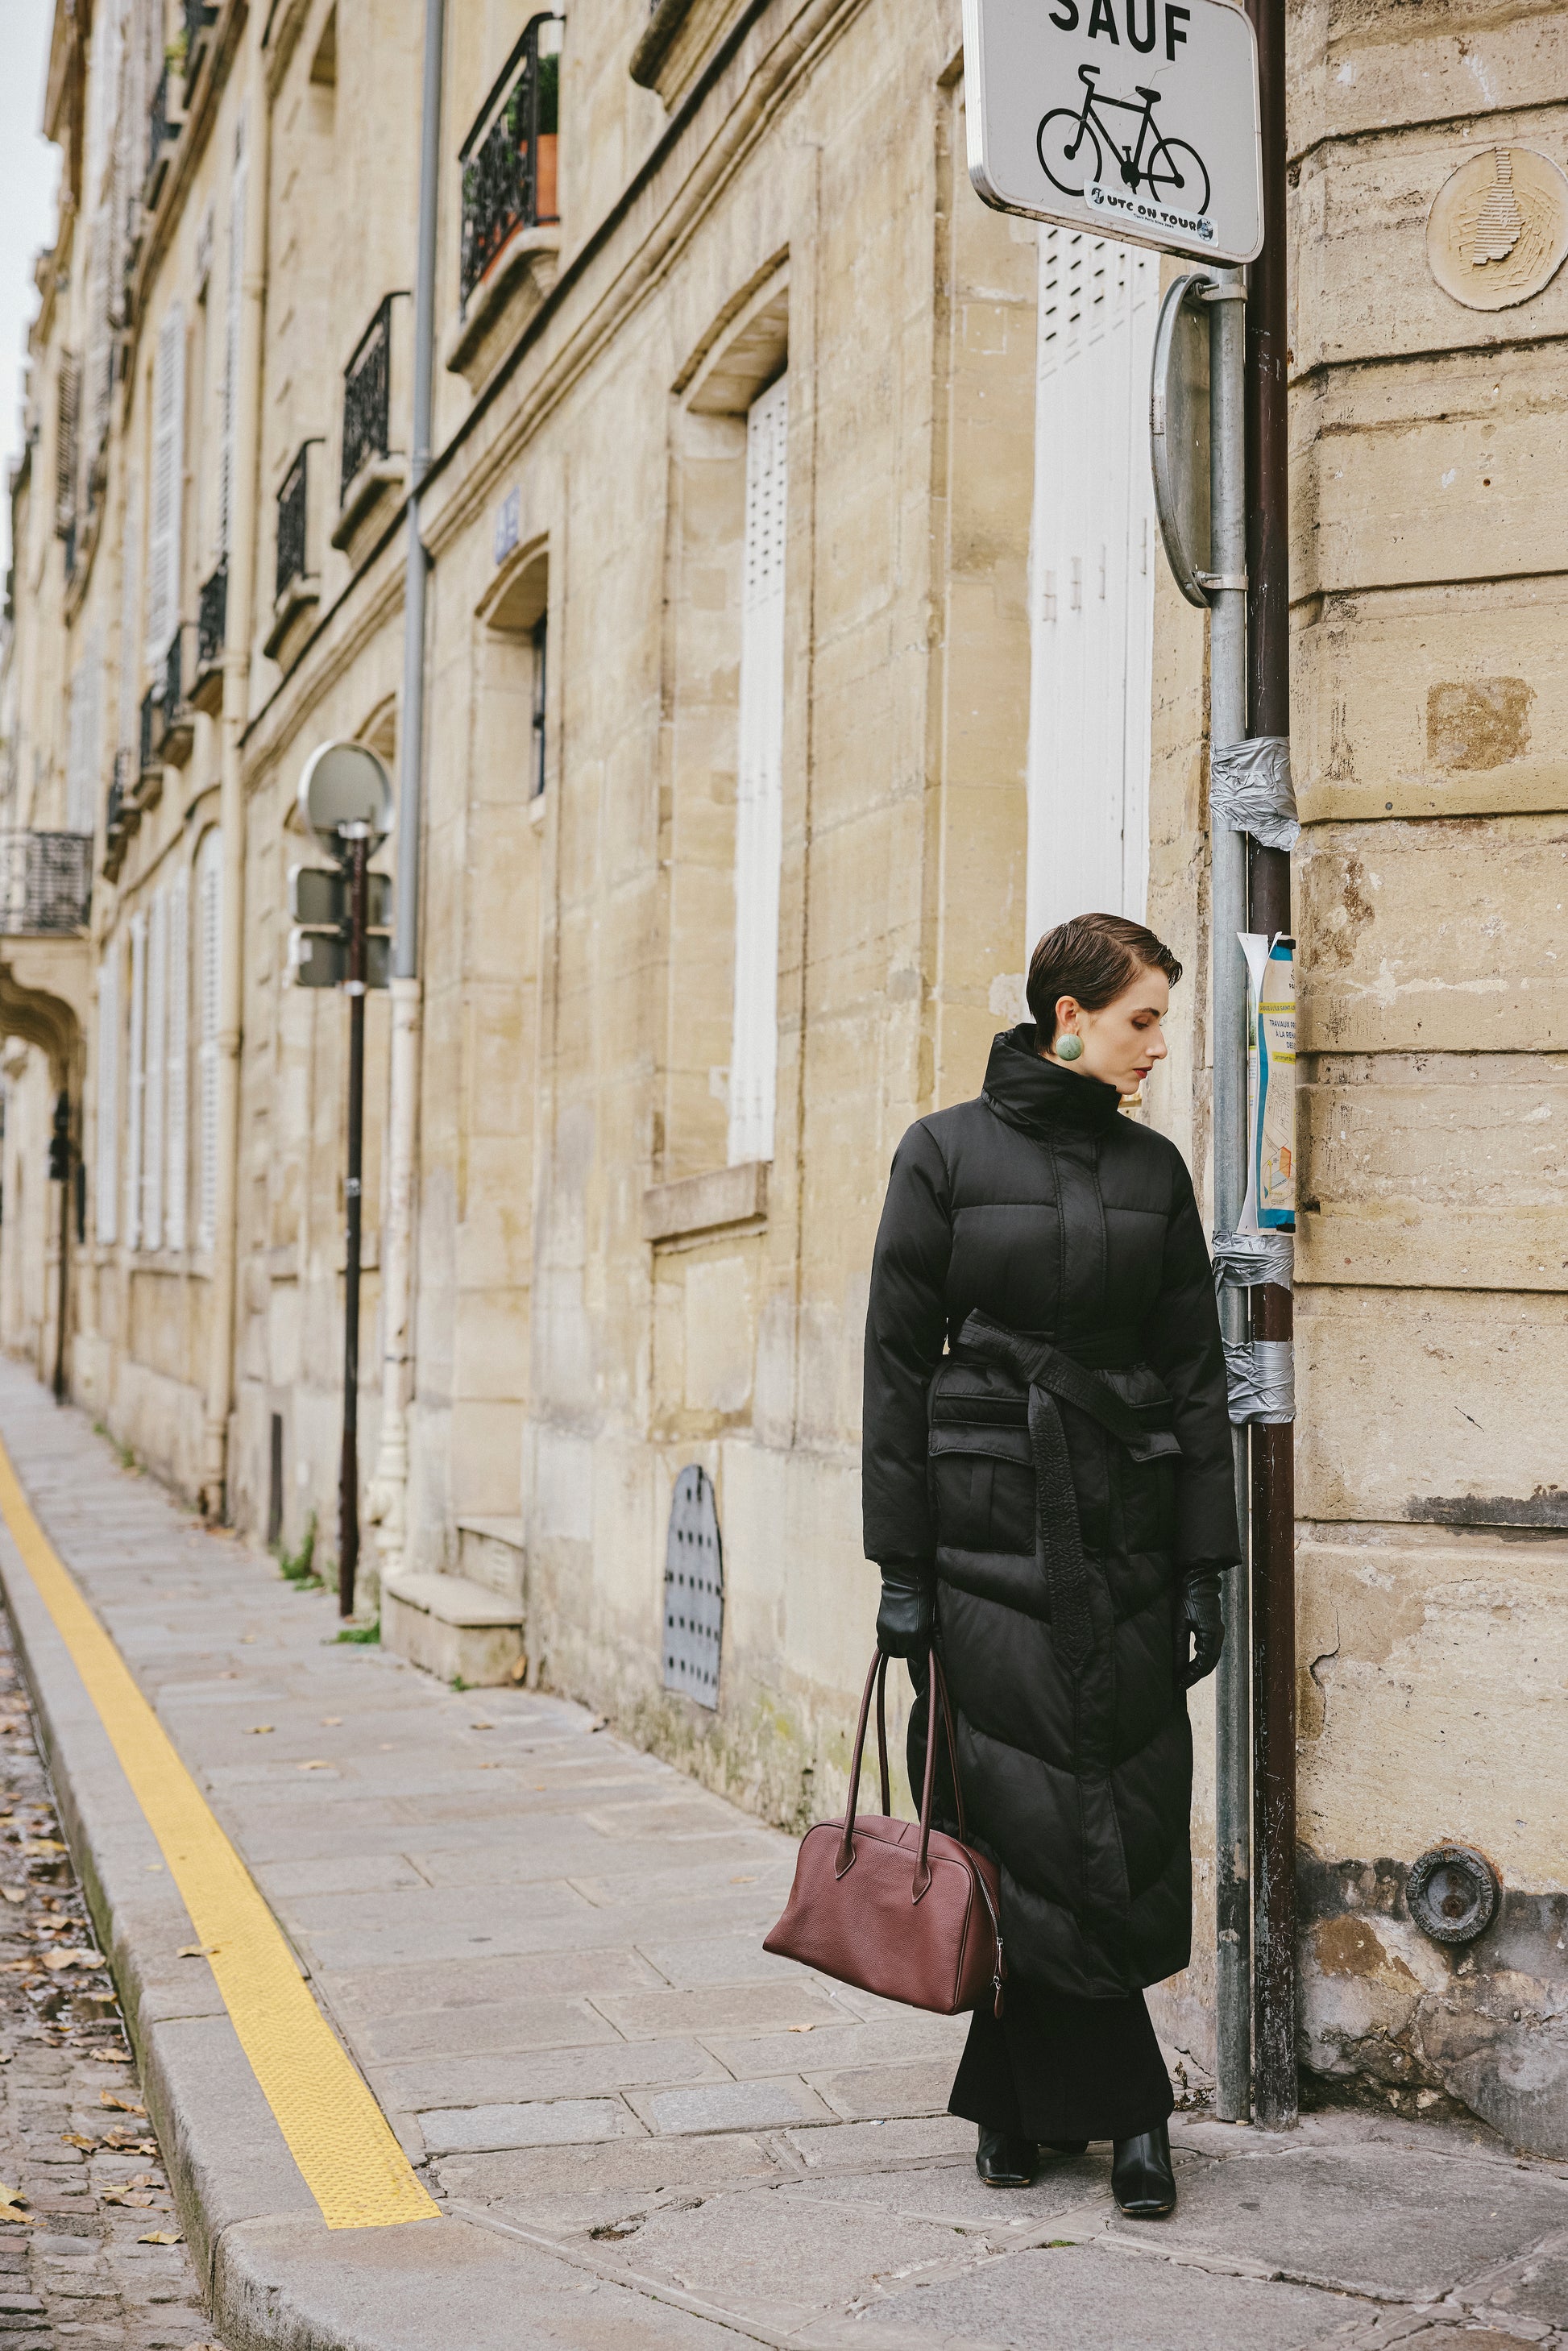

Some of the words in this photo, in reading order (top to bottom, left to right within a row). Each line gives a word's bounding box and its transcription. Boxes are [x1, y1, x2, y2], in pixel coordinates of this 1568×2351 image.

[1048, 0, 1190, 61] SAUF
[1107, 195, 1133, 211] UTC
[1138, 205, 1157, 218] ON
[1160, 212, 1197, 231] TOUR
[1269, 1019, 1290, 1028] TRAVAUX
